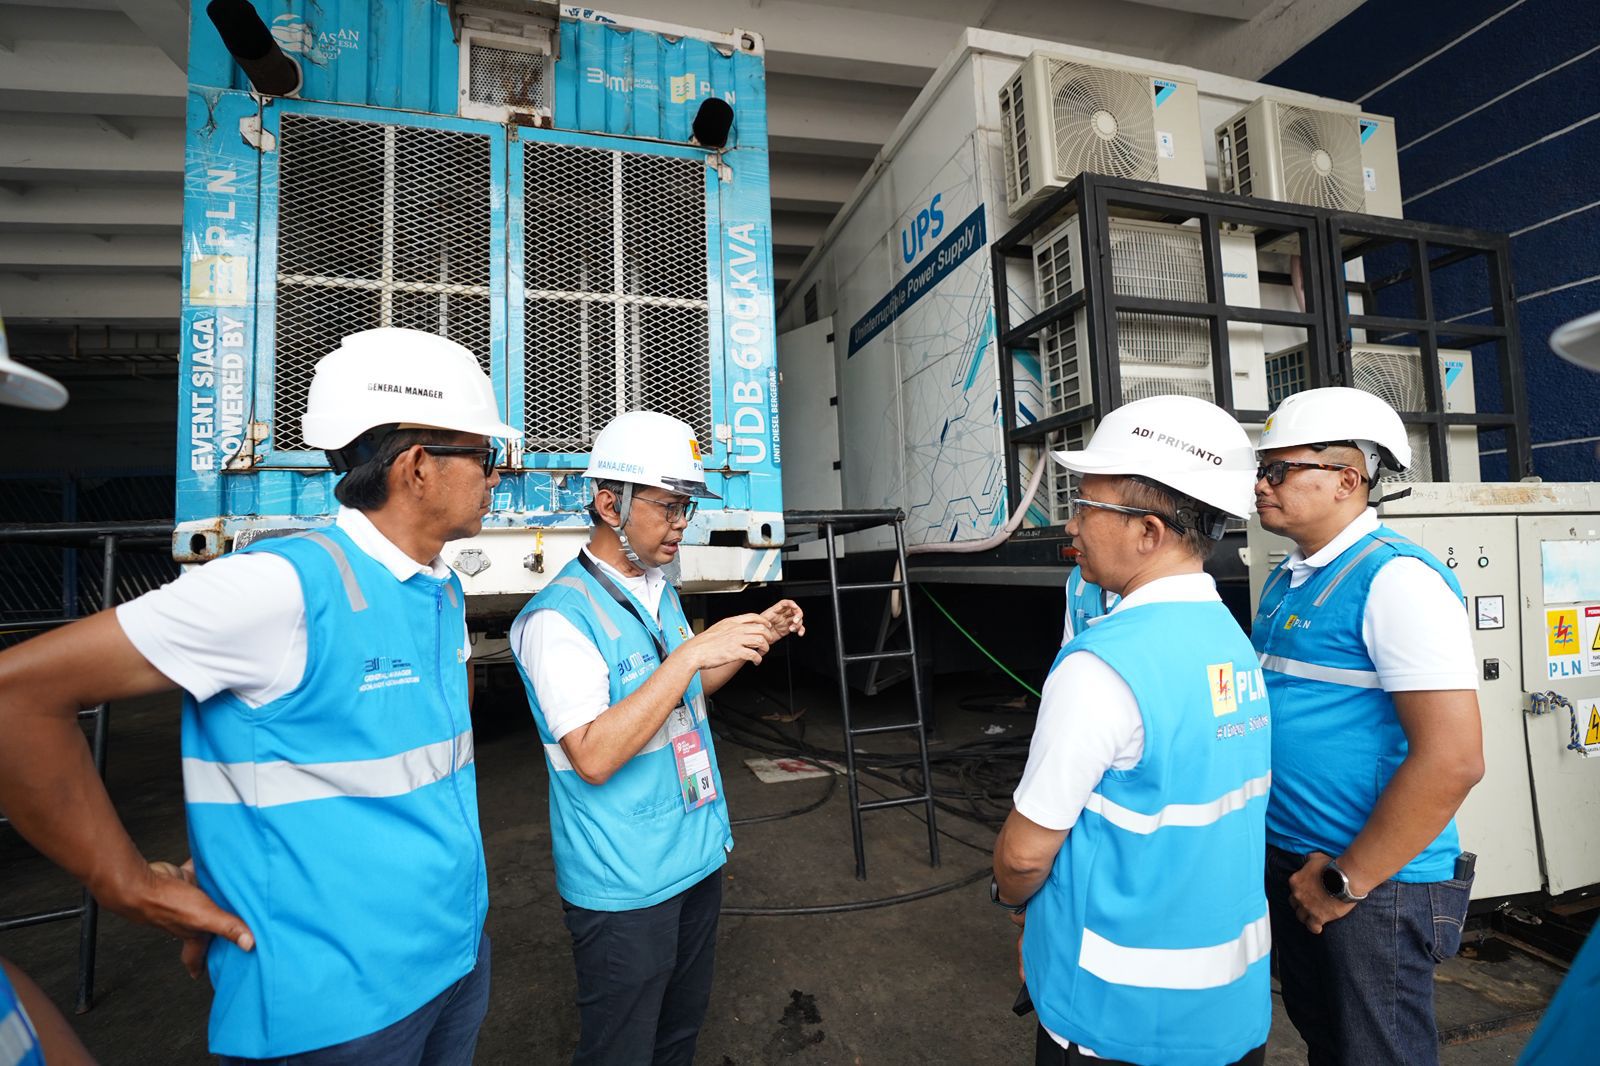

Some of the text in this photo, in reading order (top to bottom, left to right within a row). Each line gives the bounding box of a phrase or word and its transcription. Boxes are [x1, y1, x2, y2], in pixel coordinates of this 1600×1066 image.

[1154, 80, 1177, 88] DAIKIN
[205, 169, 237, 246] PLN
[902, 193, 945, 264] UPS
[855, 224, 975, 343] Uninterruptible Power Supply
[222, 316, 245, 347] BY
[191, 318, 215, 471] EVENT SIAGA
[368, 383, 443, 399] GENERAL MANAGER
[733, 381, 767, 464] UDB
[769, 368, 781, 463] UNIT DIESEL BERGERAK
[1131, 427, 1223, 466] ADI PRIYANTO
[597, 460, 645, 475] MANAJEMEN
[1448, 546, 1454, 556] S
[1478, 546, 1484, 555] T
[1293, 618, 1312, 630] PLN
[1549, 659, 1582, 677] PLN
[1235, 667, 1266, 704] PLN
